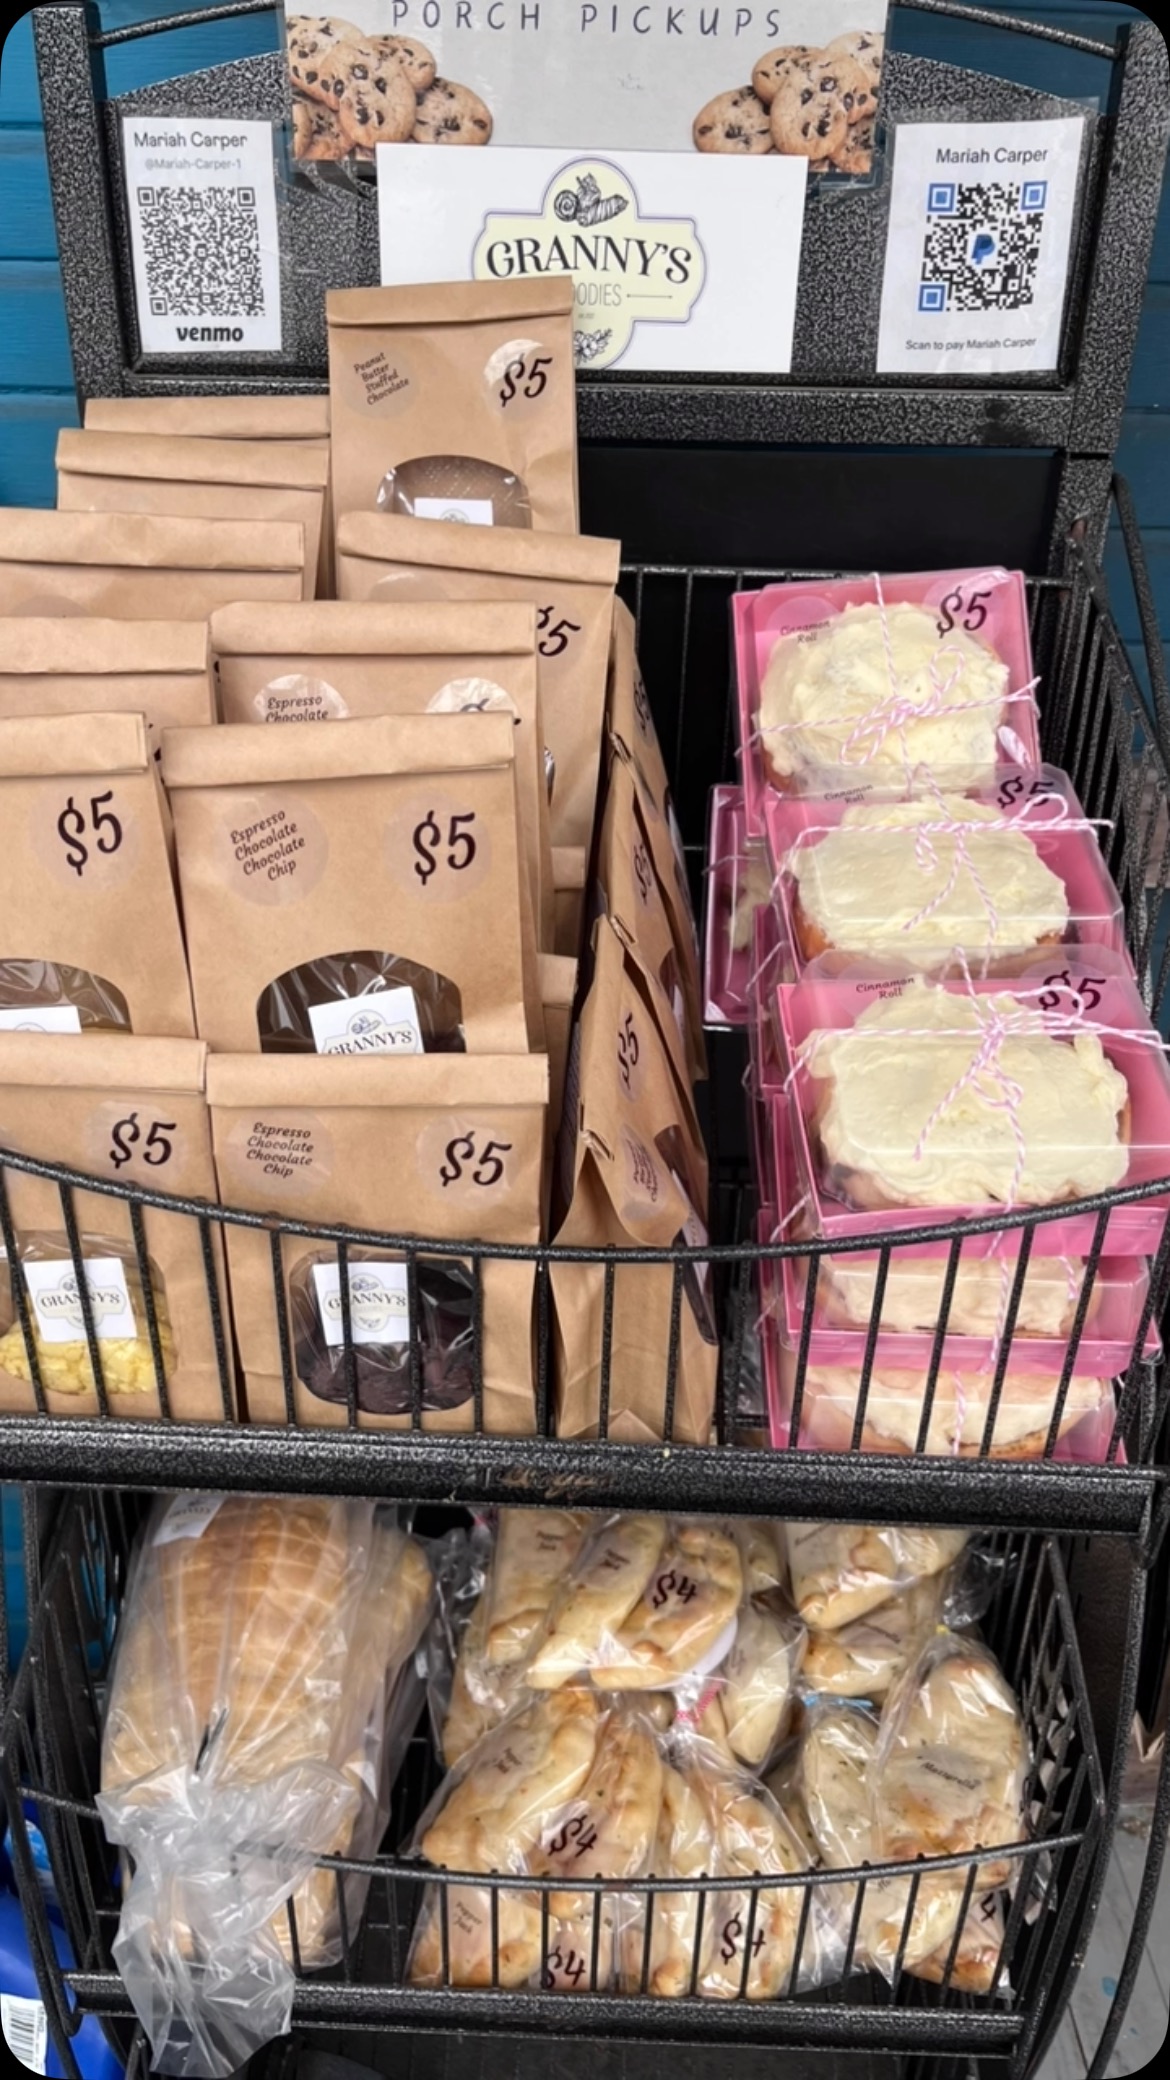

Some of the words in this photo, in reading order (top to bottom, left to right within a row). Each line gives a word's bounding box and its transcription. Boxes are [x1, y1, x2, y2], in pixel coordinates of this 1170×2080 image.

[392, 1, 540, 30] PORCH
[581, 5, 781, 37] PICKUPS
[134, 131, 187, 148] Mariah
[190, 131, 248, 151] Carper
[936, 149, 990, 164] Mariah
[994, 147, 1049, 166] Carper
[486, 234, 693, 284] GRANNY'S
[571, 282, 622, 307] ODIES
[176, 326, 244, 342] venmo
[905, 339, 932, 351] Scan
[933, 339, 945, 350] to
[945, 341, 964, 352] pay
[966, 338, 1001, 350] Mariah
[1003, 337, 1037, 350] Carper
[353, 352, 386, 374] Peanut
[361, 363, 390, 382] Butter
[365, 369, 400, 394] Stuffed
[366, 378, 410, 406] Chocolate
[499, 353, 553, 408] $5
[936, 584, 992, 638] $5
[265, 708, 329, 723] Chocolate
[267, 694, 323, 712] Espresso
[57, 790, 123, 877] $5
[229, 809, 286, 845] Espresso
[234, 821, 298, 862] Chocolate
[412, 809, 477, 886] $5
[242, 835, 306, 877] Chocolate
[267, 858, 297, 882] Chip
[855, 977, 915, 994] Cinnamon
[878, 986, 903, 1000] Roll
[1038, 969, 1107, 1011] $5
[109, 1111, 177, 1169] $5
[252, 1121, 311, 1141] Espresso
[246, 1135, 314, 1154] Chocolate
[245, 1149, 313, 1167] Chocolate
[263, 1163, 294, 1178] Chip
[439, 1130, 513, 1187] $5
[328, 1292, 407, 1310] GANNY'S
[652, 1570, 698, 1609] $4
[548, 1814, 598, 1858] $4
